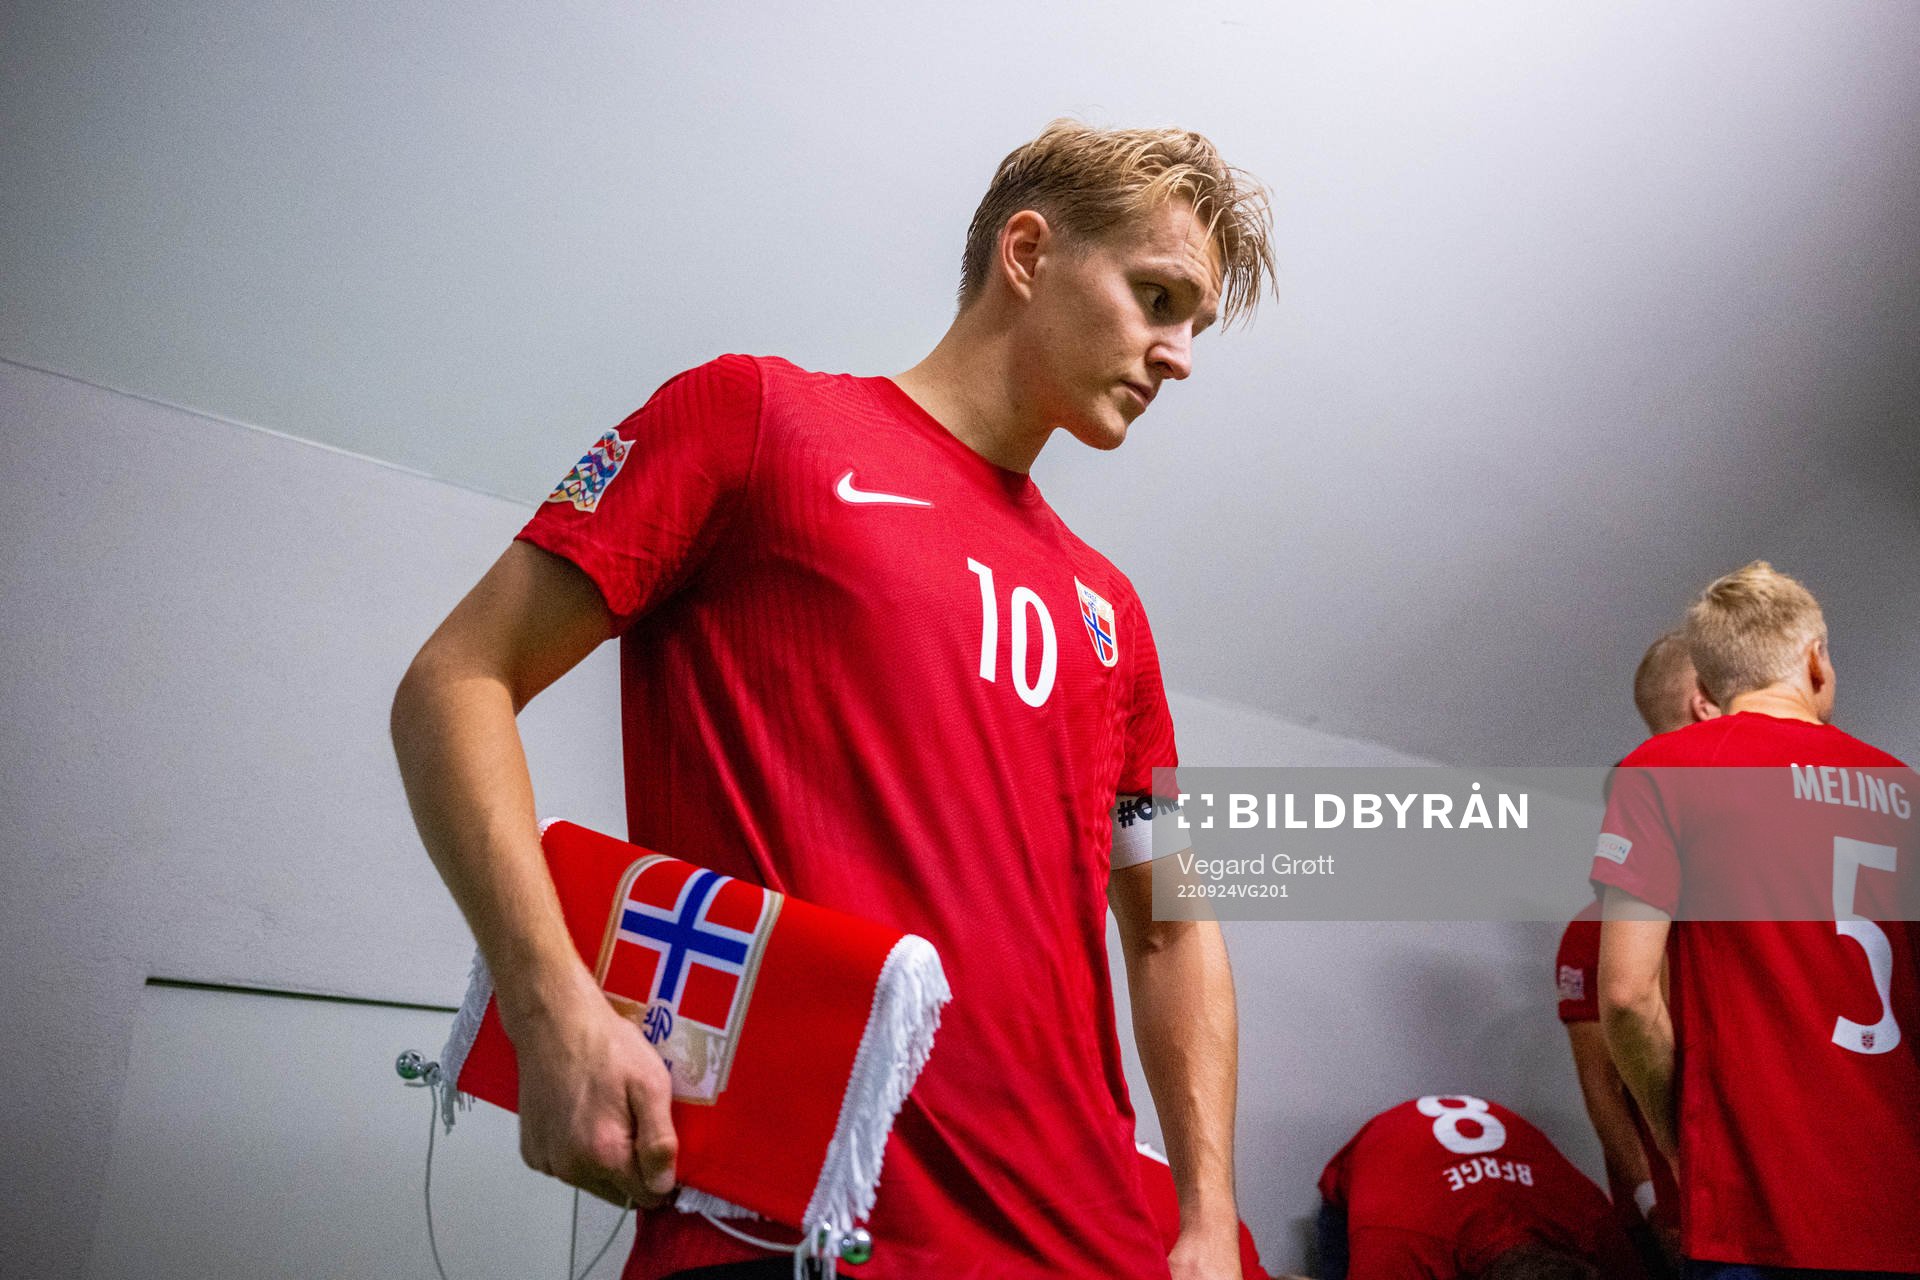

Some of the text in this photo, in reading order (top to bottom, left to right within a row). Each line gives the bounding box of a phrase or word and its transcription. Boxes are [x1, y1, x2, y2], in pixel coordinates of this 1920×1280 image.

[967, 557, 1057, 708] 10
[1790, 763, 1911, 819] MELING
[1832, 836, 1901, 1055] 5
[1416, 1094, 1507, 1155] 8
